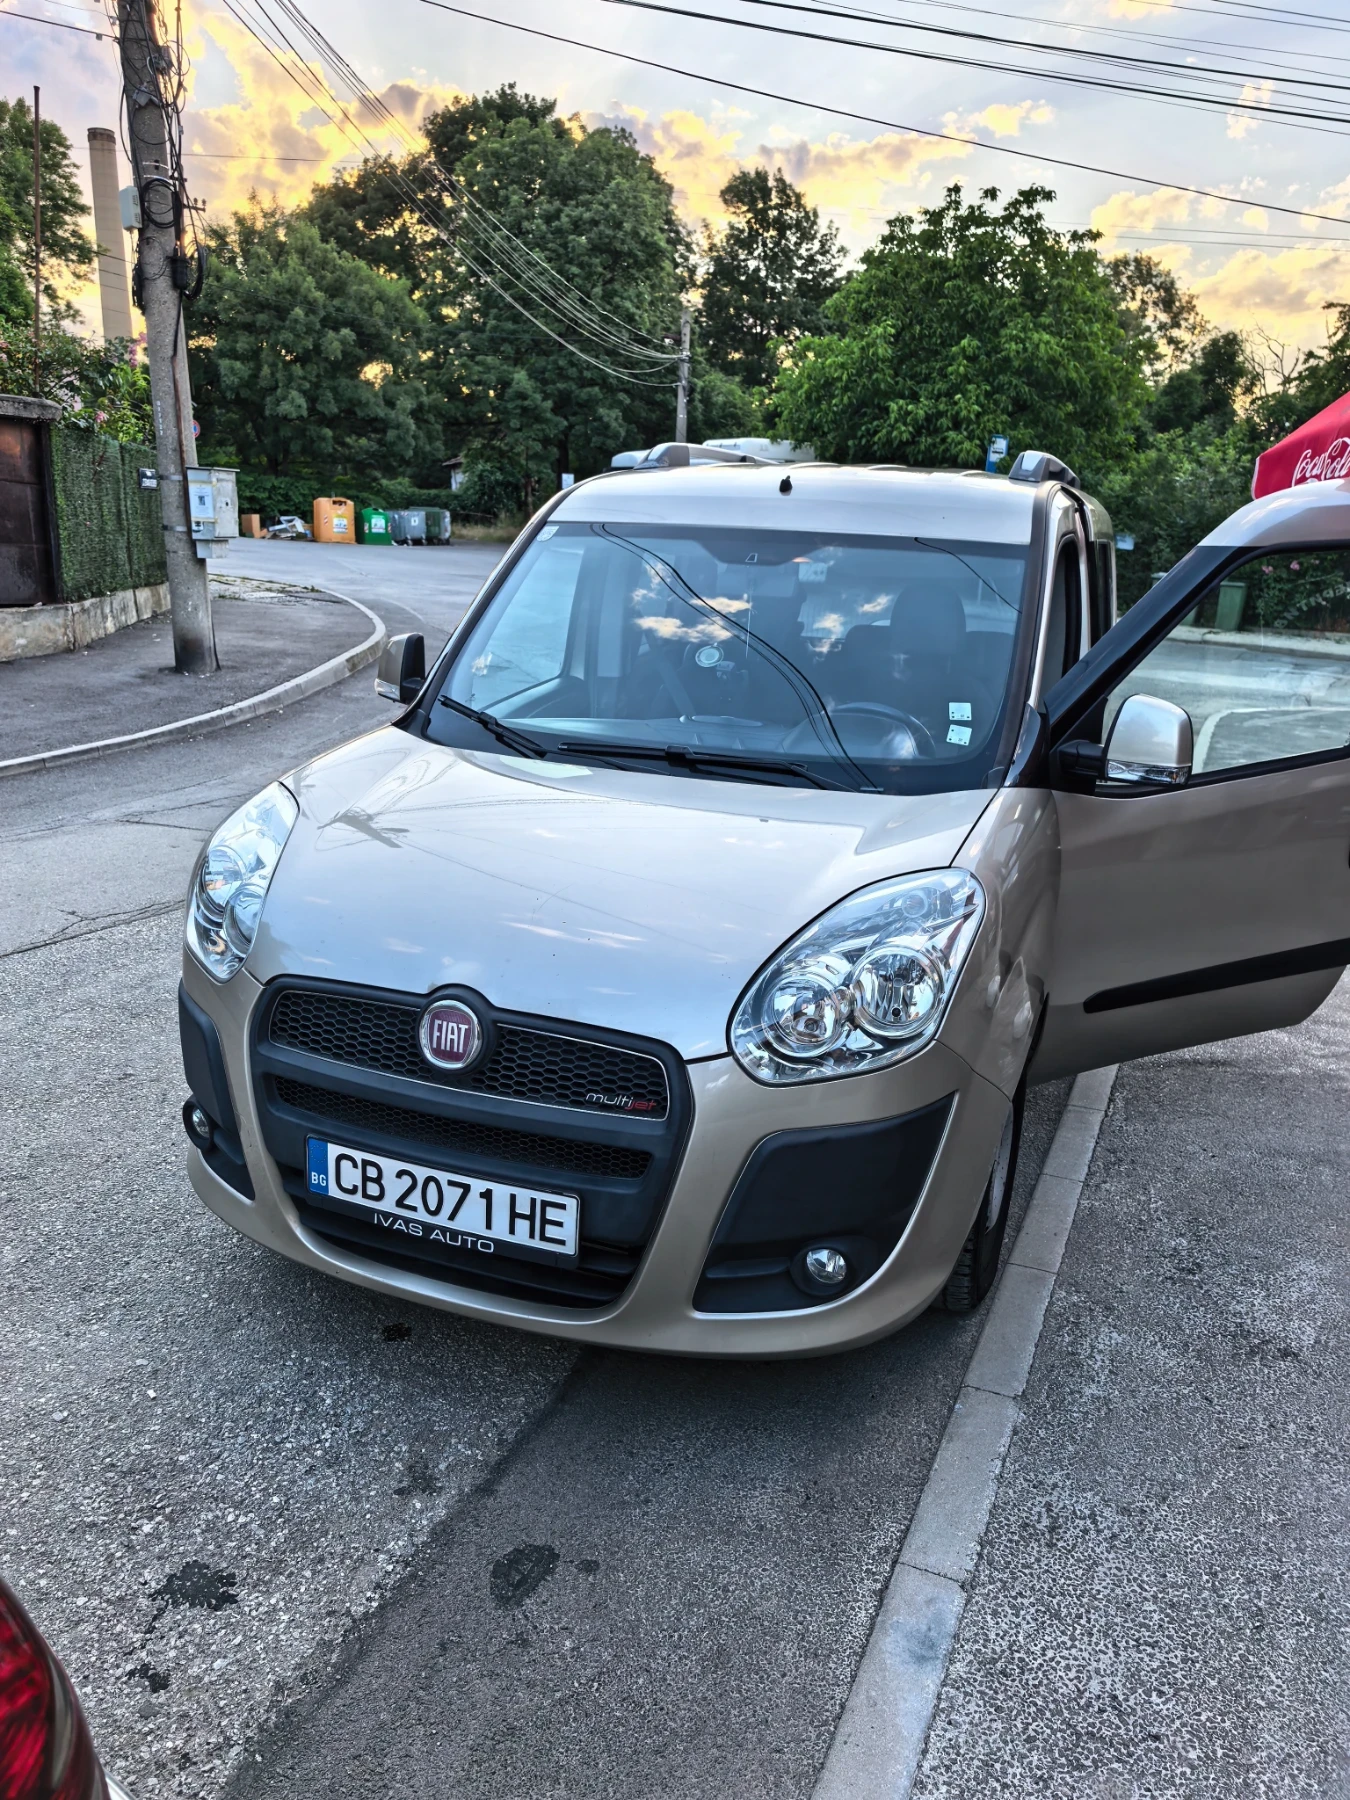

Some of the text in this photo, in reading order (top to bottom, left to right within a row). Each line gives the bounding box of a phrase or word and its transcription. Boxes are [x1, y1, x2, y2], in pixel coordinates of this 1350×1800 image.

[432, 1019, 469, 1053] FIAT
[585, 1093, 657, 1111] multijet
[311, 1171, 327, 1186] BG
[374, 1213, 494, 1253] IVAS AUTO
